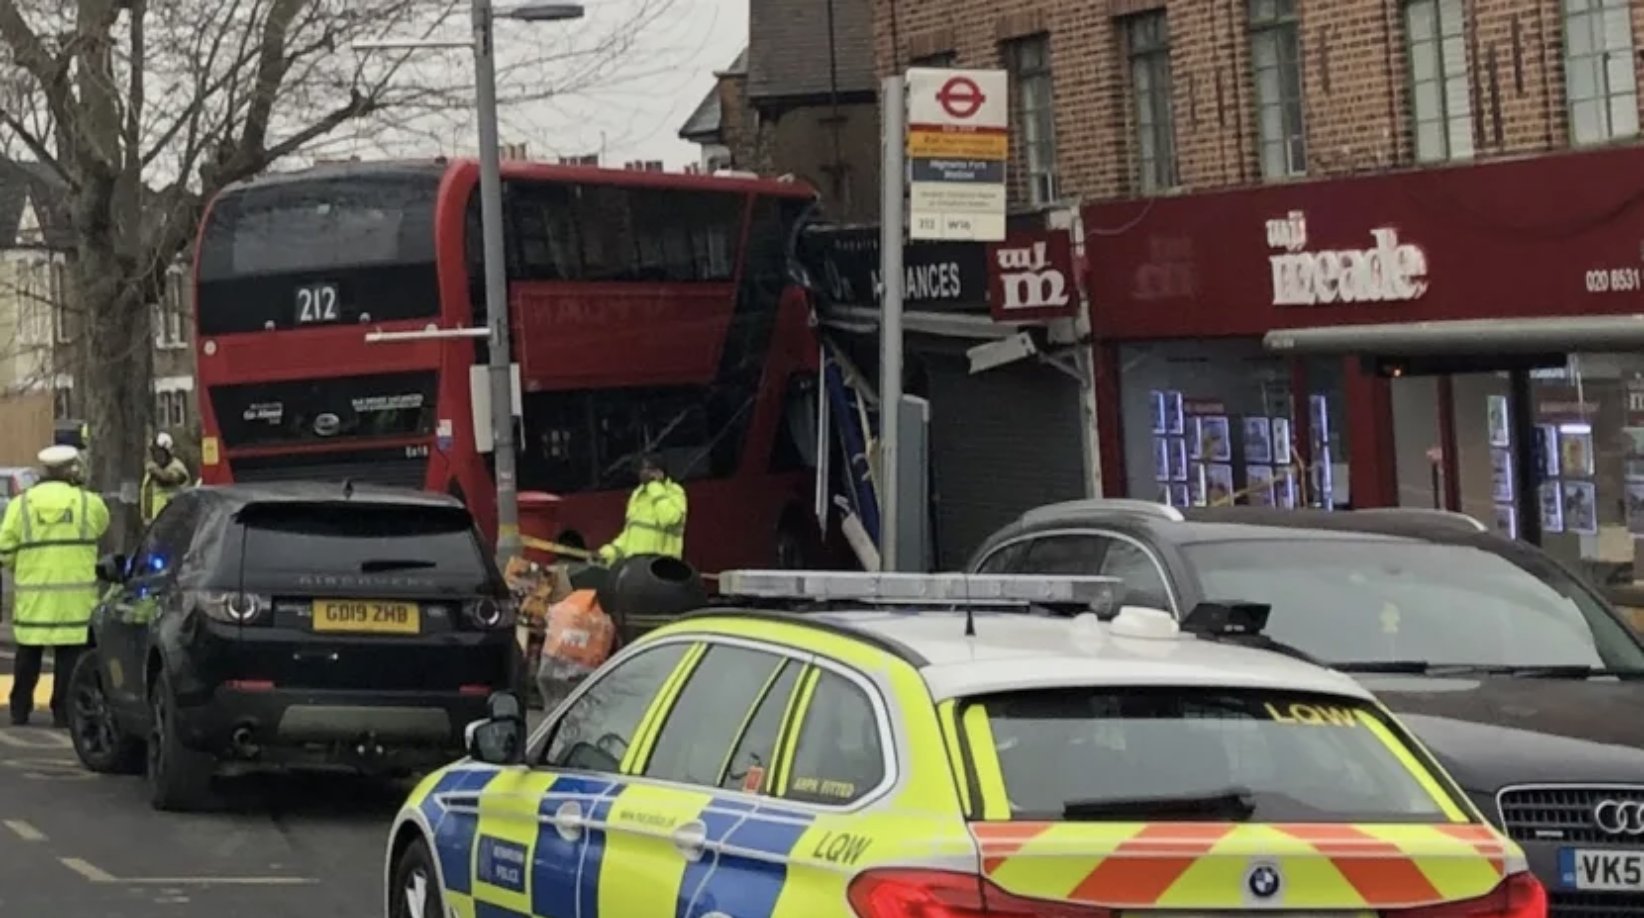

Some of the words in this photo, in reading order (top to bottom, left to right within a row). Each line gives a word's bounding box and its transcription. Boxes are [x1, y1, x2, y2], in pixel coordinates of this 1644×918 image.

[1000, 269, 1069, 309] m
[1586, 270, 1609, 292] 020
[1610, 268, 1640, 291] 8531
[298, 286, 336, 321] 212
[1264, 702, 1356, 727] LQW
[821, 780, 855, 798] FITTED
[812, 831, 873, 865] LQW
[1583, 855, 1641, 885] VK5
